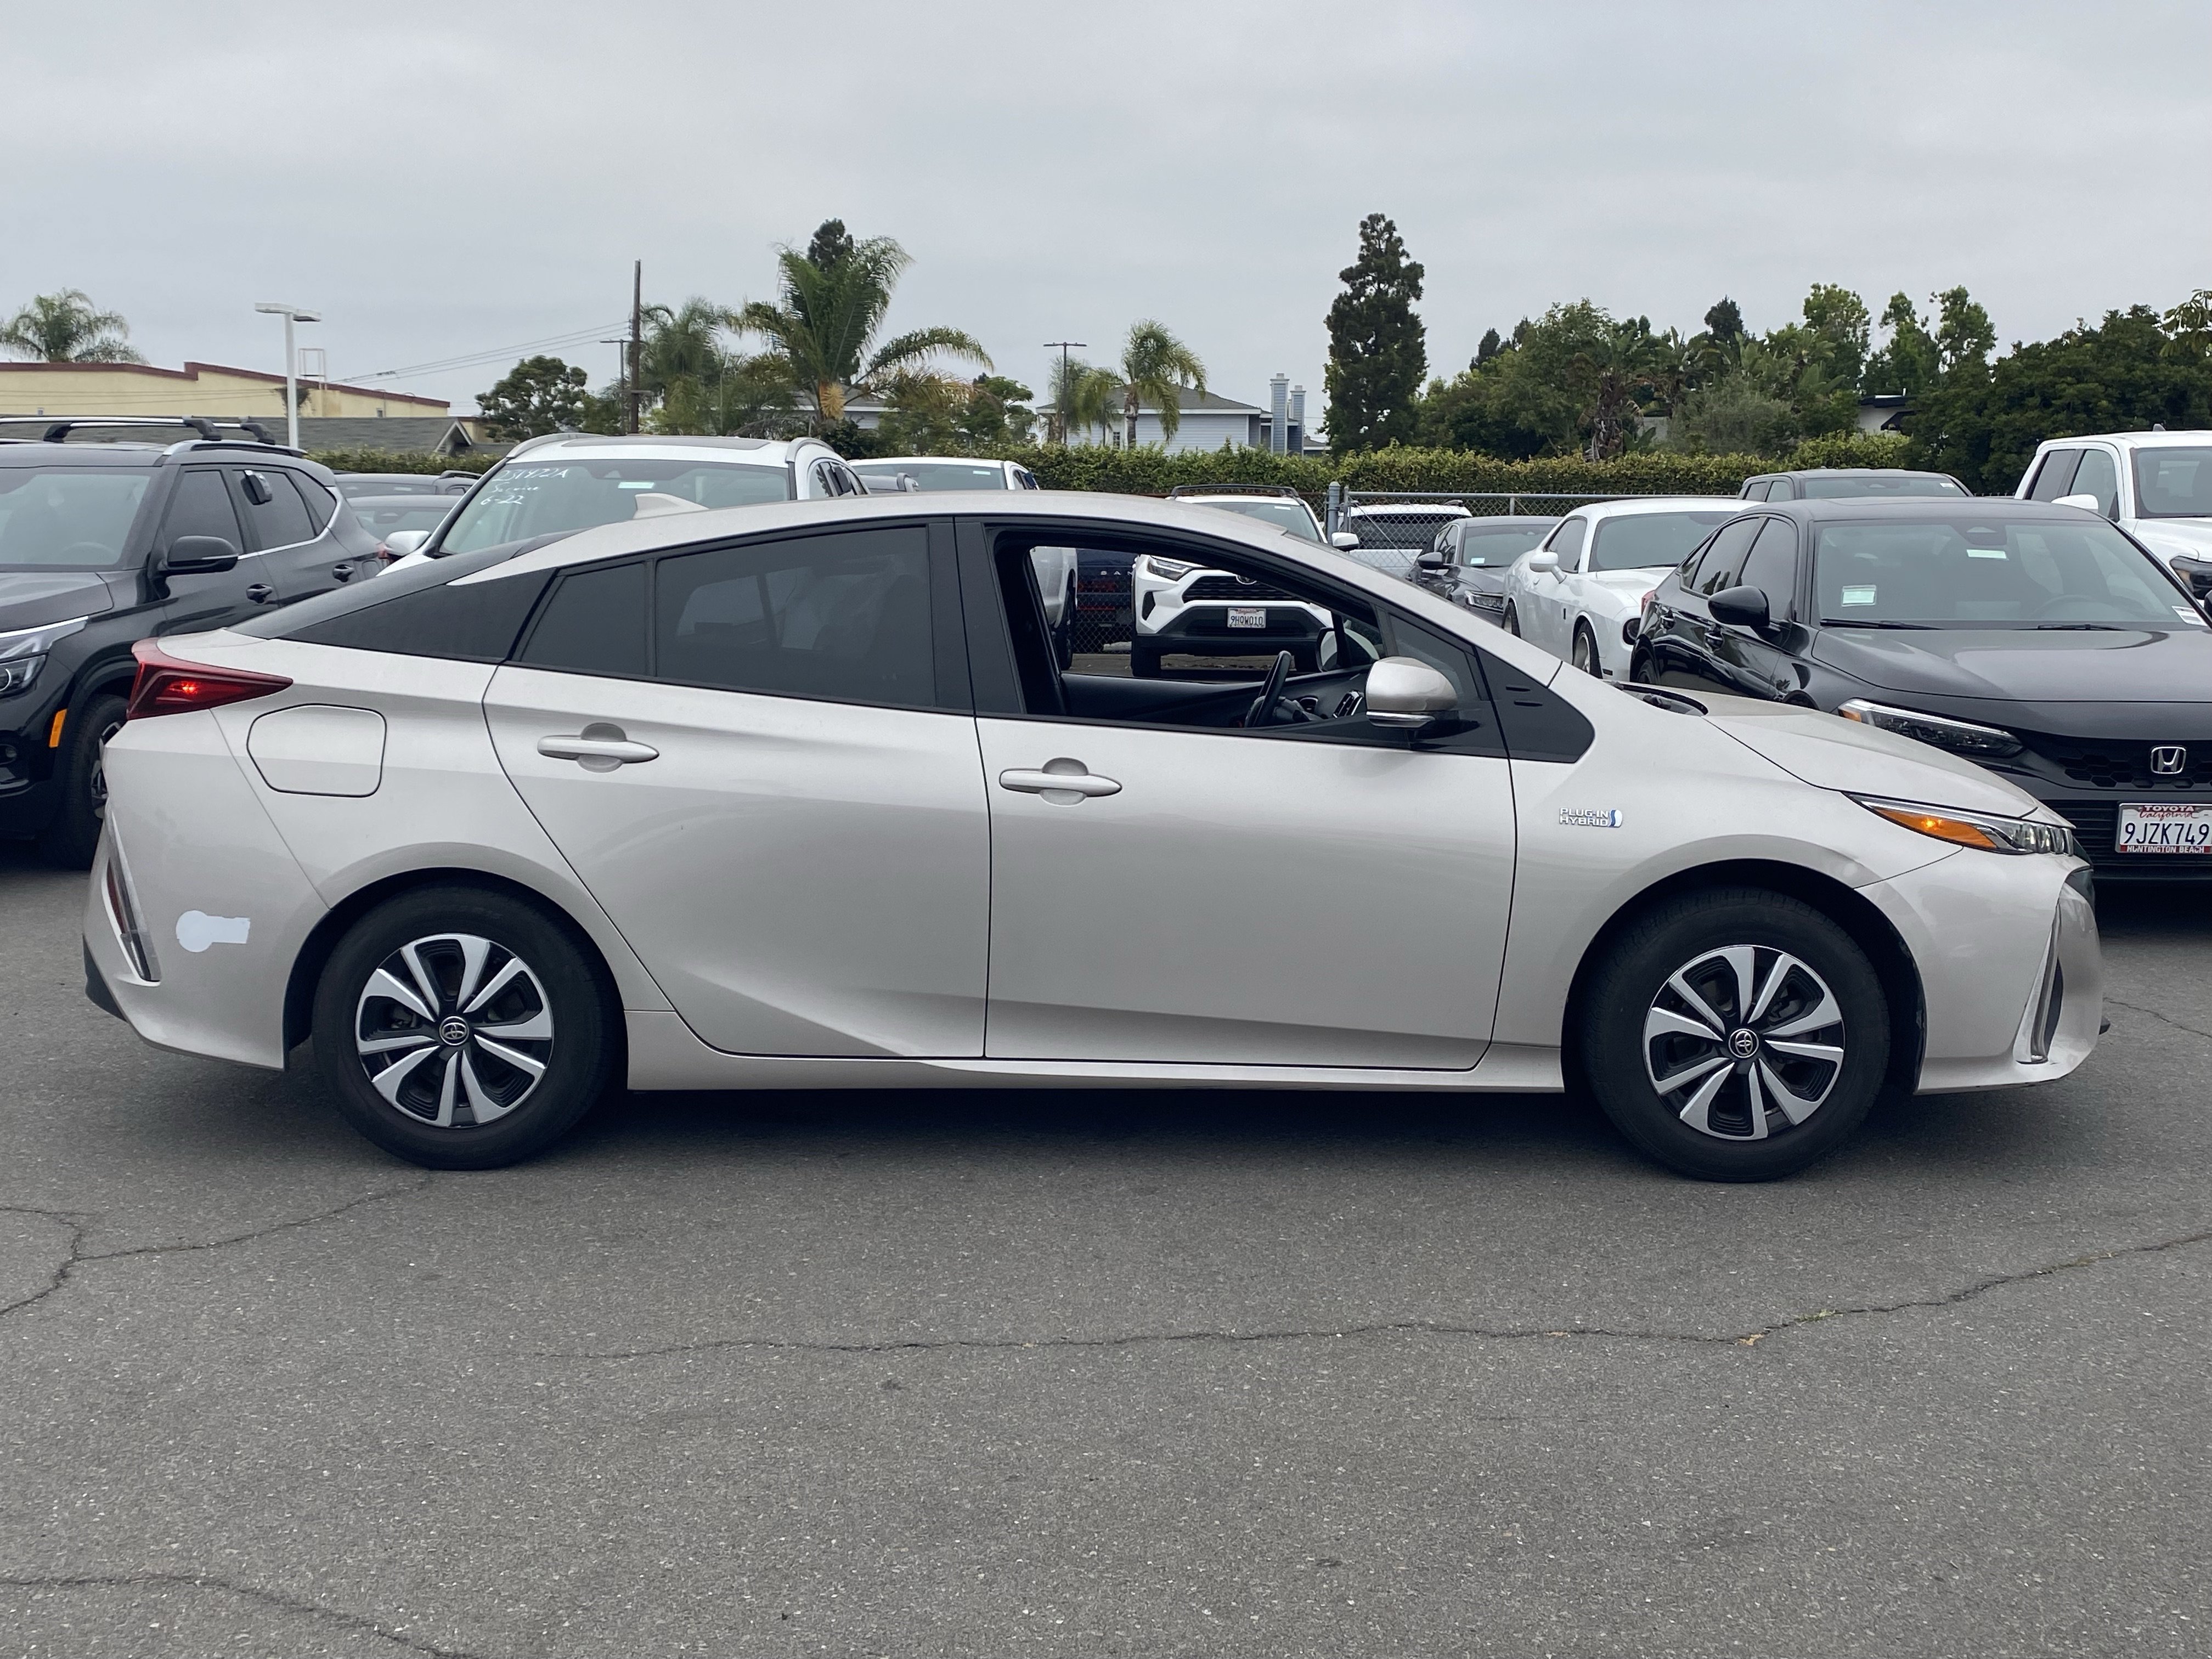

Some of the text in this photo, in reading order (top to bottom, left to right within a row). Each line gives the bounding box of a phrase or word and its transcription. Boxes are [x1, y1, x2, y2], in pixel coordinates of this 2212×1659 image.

[1559, 808, 1609, 819] PLUG-IN
[1559, 816, 1609, 826] HYBRID
[2124, 822, 2210, 845] 9JZK749
